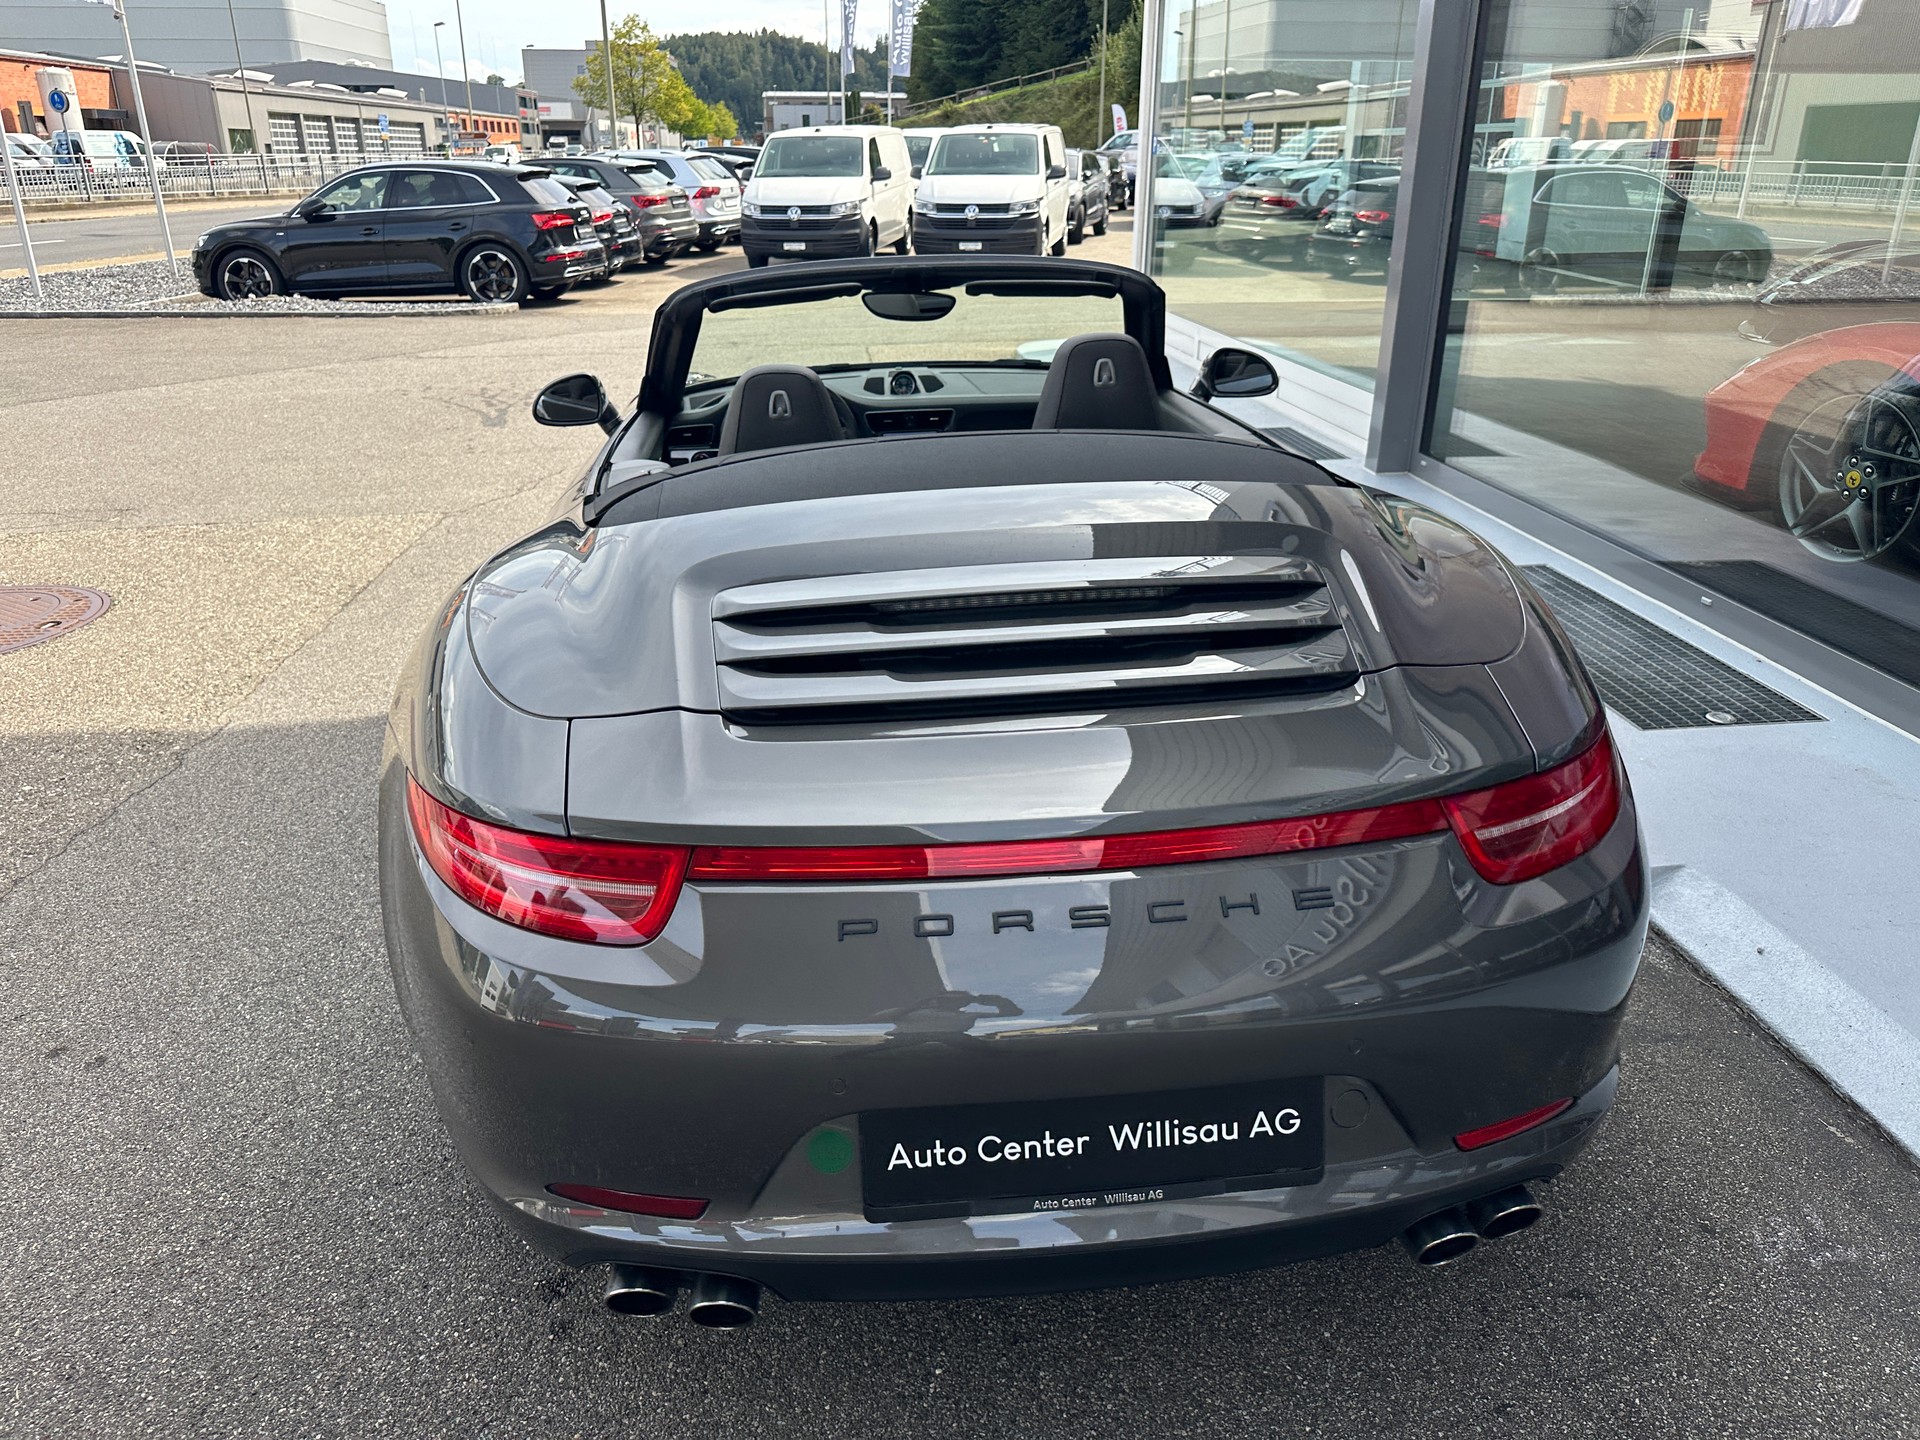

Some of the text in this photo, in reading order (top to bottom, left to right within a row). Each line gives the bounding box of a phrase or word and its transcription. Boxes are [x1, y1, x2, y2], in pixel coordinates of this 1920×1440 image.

[893, 13, 903, 64] Auto
[900, 7, 913, 65] Willisau
[837, 886, 1336, 943] PORSCHE
[887, 1108, 1301, 1171] Auto Center Willisau AG
[1033, 1189, 1164, 1210] Auto Center Willisau AG
